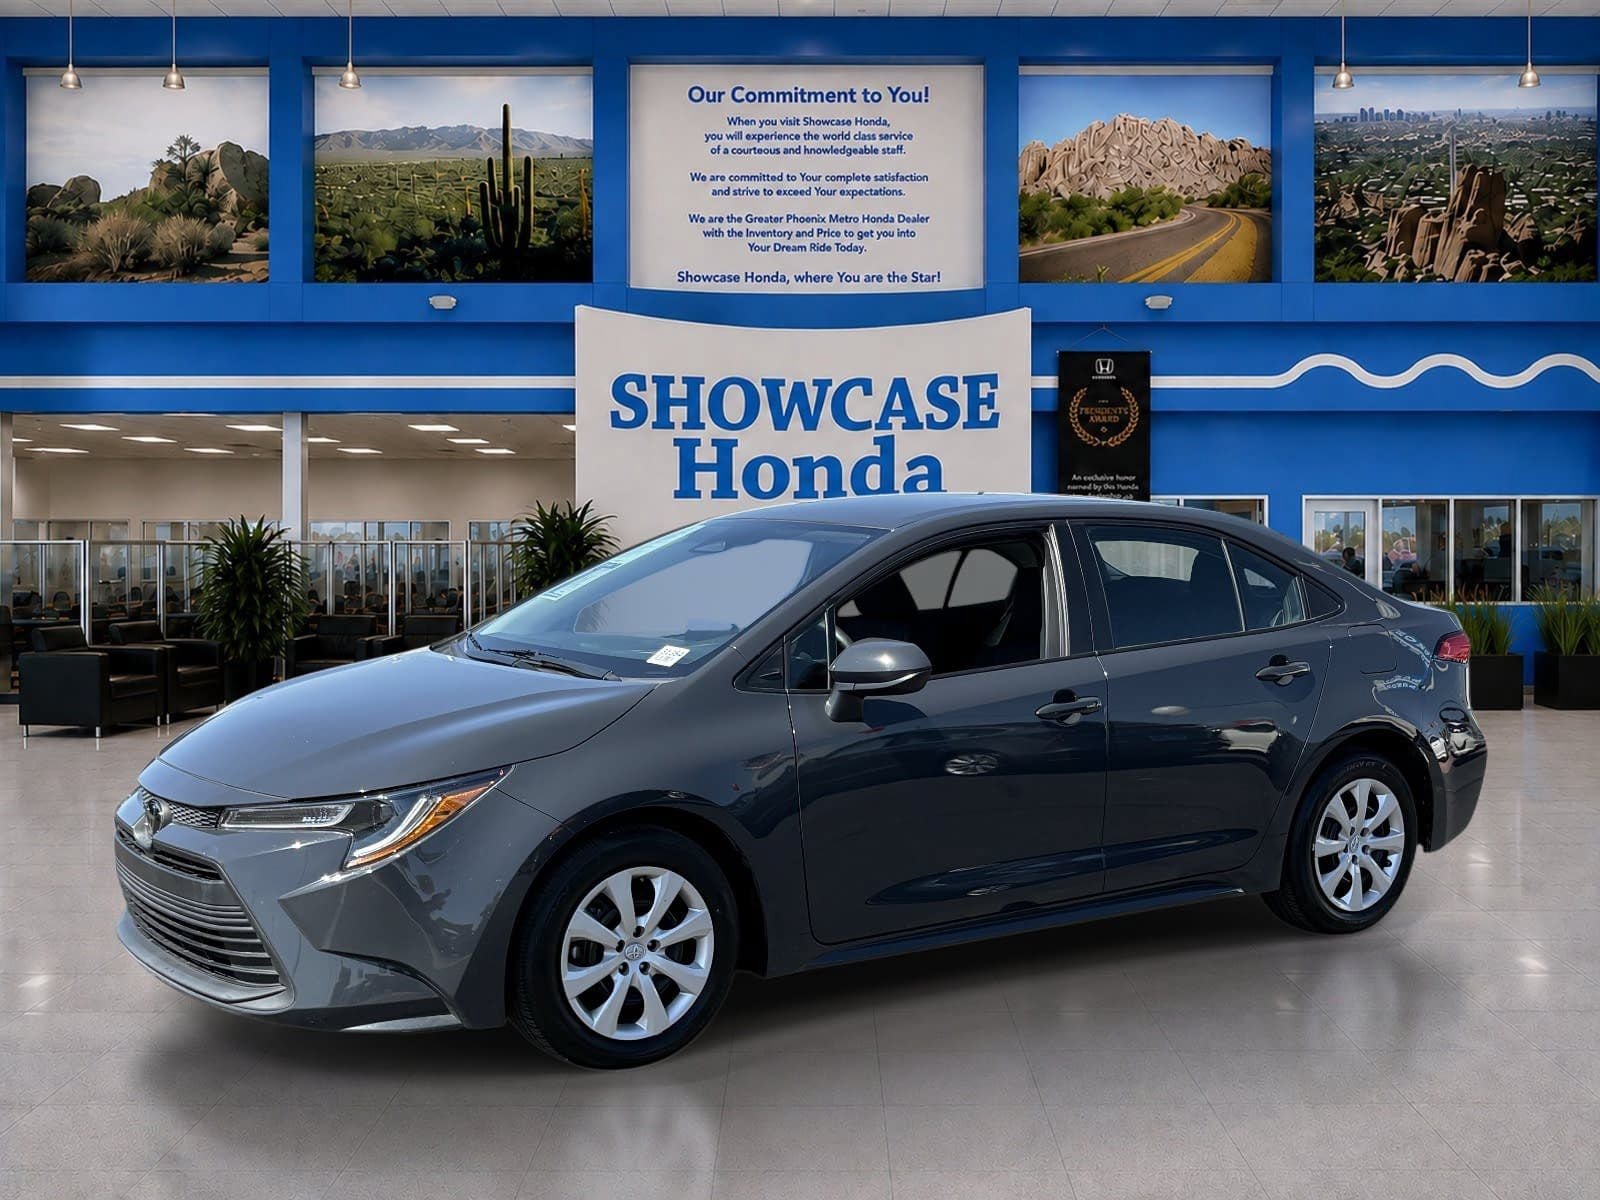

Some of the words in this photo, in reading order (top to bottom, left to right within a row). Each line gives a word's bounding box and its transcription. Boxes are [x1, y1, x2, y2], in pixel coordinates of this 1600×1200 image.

[687, 85, 726, 104] Our
[730, 85, 857, 104] Commitment
[861, 87, 883, 104] to
[886, 85, 929, 104] You!
[726, 115, 757, 127] When
[758, 118, 778, 129] you
[779, 116, 801, 127] visit
[802, 116, 853, 127] Showcase
[854, 116, 891, 128] Honda,
[704, 133, 724, 144] you
[725, 130, 743, 141] will
[744, 130, 801, 144] experience
[802, 130, 821, 141] the
[821, 130, 851, 142] world
[852, 130, 877, 141] class
[878, 130, 914, 142] service
[709, 144, 722, 155] of
[722, 147, 730, 155] a
[730, 146, 781, 156] courteous
[782, 144, 802, 155] and
[881, 144, 907, 155] staff.
[689, 171, 708, 183] We
[709, 174, 727, 182] are
[728, 171, 784, 183] committed
[785, 173, 798, 183] to
[799, 172, 823, 183] Your
[824, 172, 872, 185] complete
[873, 171, 929, 183] satisfaction
[711, 185, 731, 197] and
[731, 186, 761, 197] strive
[762, 187, 774, 197] to
[775, 186, 812, 197] exceed
[813, 186, 838, 197] Your
[838, 186, 906, 200] expectations.
[688, 213, 706, 225] We
[707, 215, 725, 224] are
[725, 213, 743, 224] the
[744, 213, 785, 224] Greater
[785, 213, 827, 224] Phoenix
[828, 213, 860, 224] Metro
[861, 213, 895, 224] Honda
[897, 213, 931, 224] Dealer
[702, 227, 725, 238] with
[726, 227, 744, 239] the
[745, 227, 794, 241] Inventory
[794, 227, 815, 239] and
[816, 227, 842, 239] Price
[843, 229, 855, 238] to
[856, 229, 875, 241] get
[876, 230, 895, 241] you
[896, 227, 917, 239] into
[747, 241, 772, 253] Your
[772, 242, 808, 253] Dream
[809, 242, 833, 253] Ride
[833, 242, 868, 255] Today.
[677, 270, 741, 284] Showcase
[744, 270, 790, 286] Honda,
[793, 270, 834, 284] where
[836, 271, 861, 284] You
[863, 274, 884, 284] are
[886, 270, 908, 284] the
[911, 271, 941, 284] Star!
[610, 372, 1000, 431] SHOWCASE
[673, 434, 947, 500] Honda
